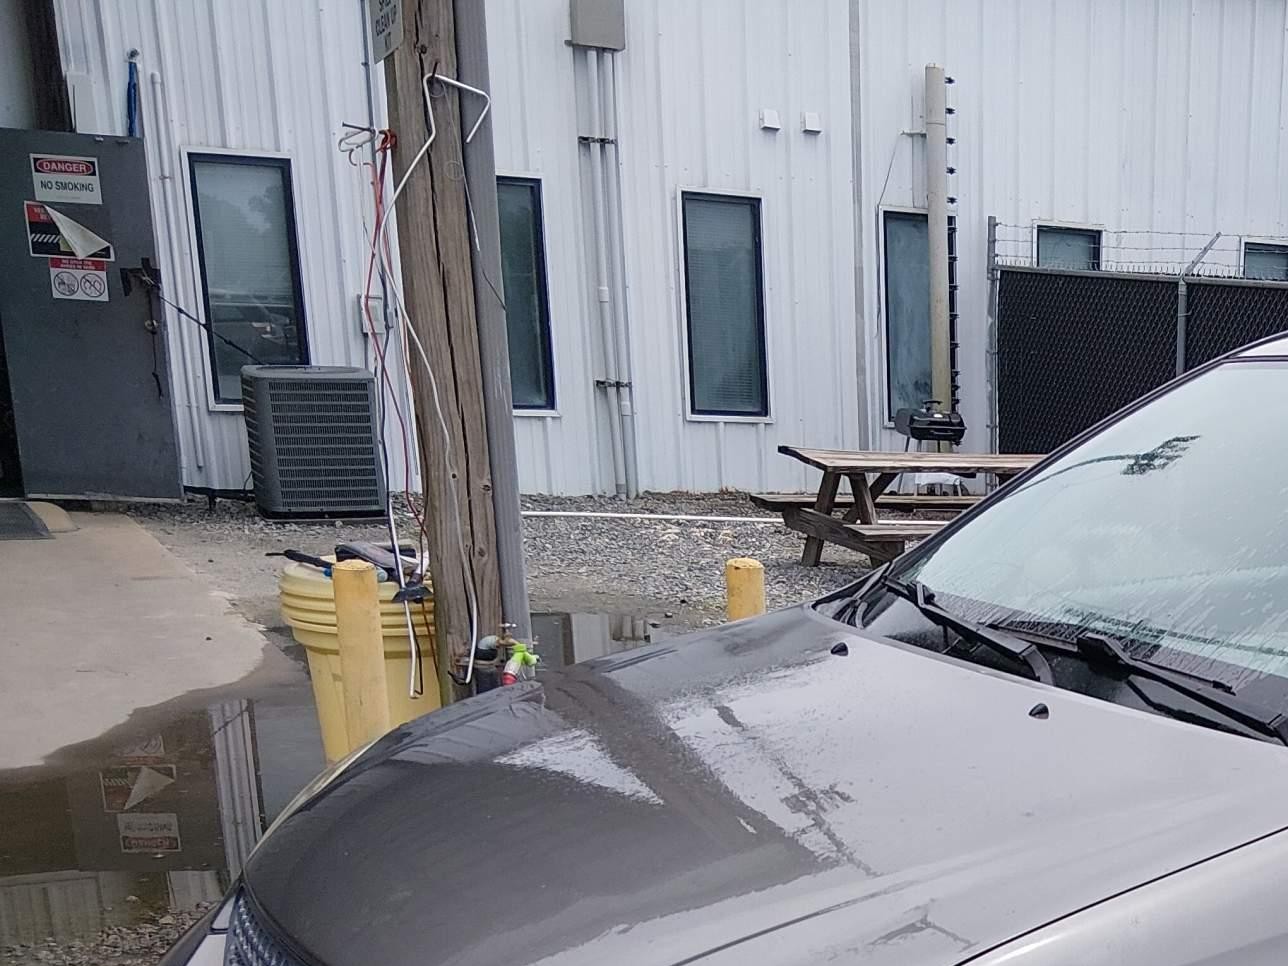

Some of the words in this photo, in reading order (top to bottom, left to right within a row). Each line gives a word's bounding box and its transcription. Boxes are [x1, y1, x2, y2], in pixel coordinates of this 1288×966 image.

[375, 12, 390, 37] CLEAN
[43, 161, 87, 172] DANGER
[40, 180, 54, 190] NO
[55, 181, 94, 192] SMOKING
